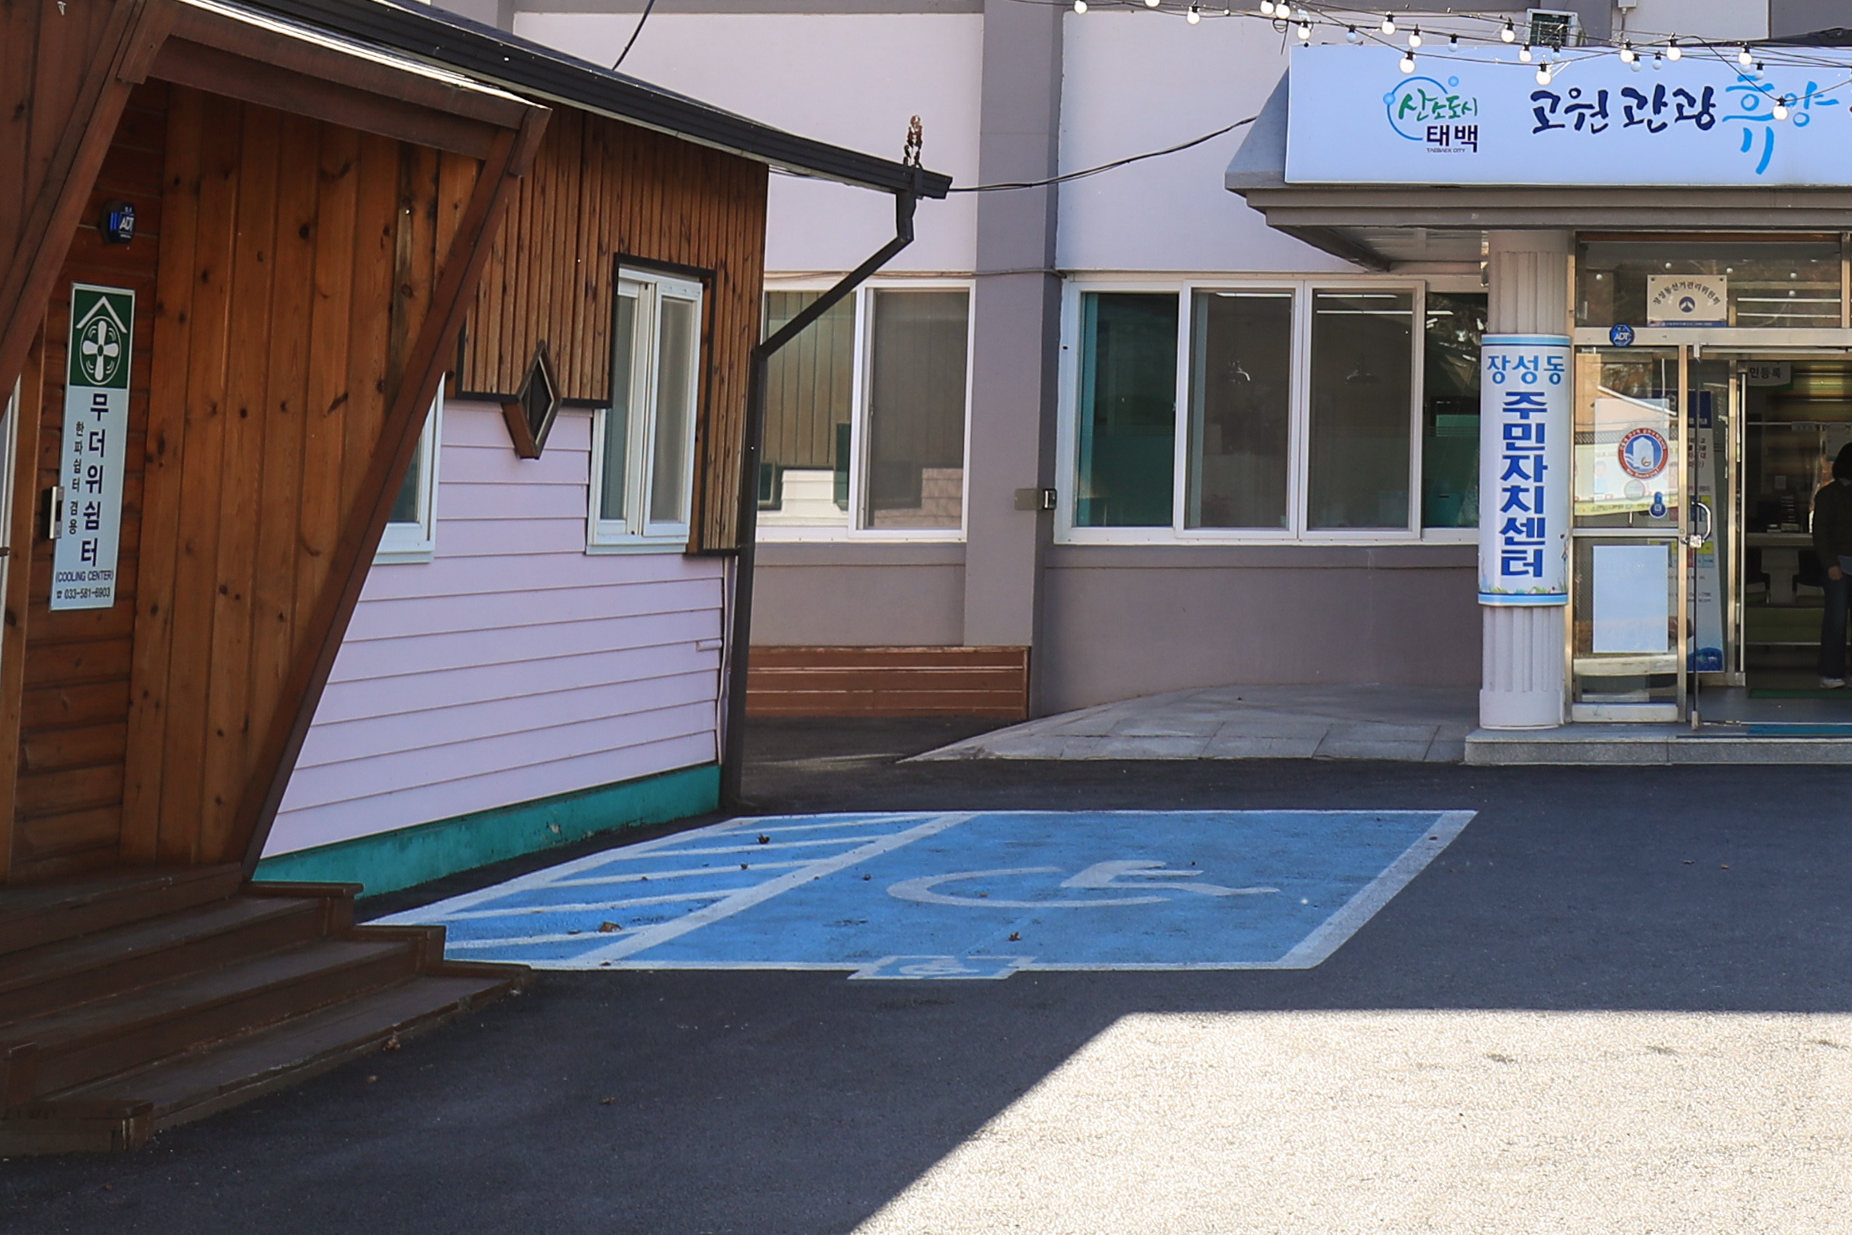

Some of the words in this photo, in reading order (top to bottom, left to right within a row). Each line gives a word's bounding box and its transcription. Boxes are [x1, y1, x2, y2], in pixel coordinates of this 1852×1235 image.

[1426, 124, 1478, 153] 태백
[1487, 355, 1565, 385] 장성동
[80, 392, 110, 567] 무더위쉼터
[1499, 391, 1548, 578] 주민자치센터
[55, 570, 86, 583] (COOLING
